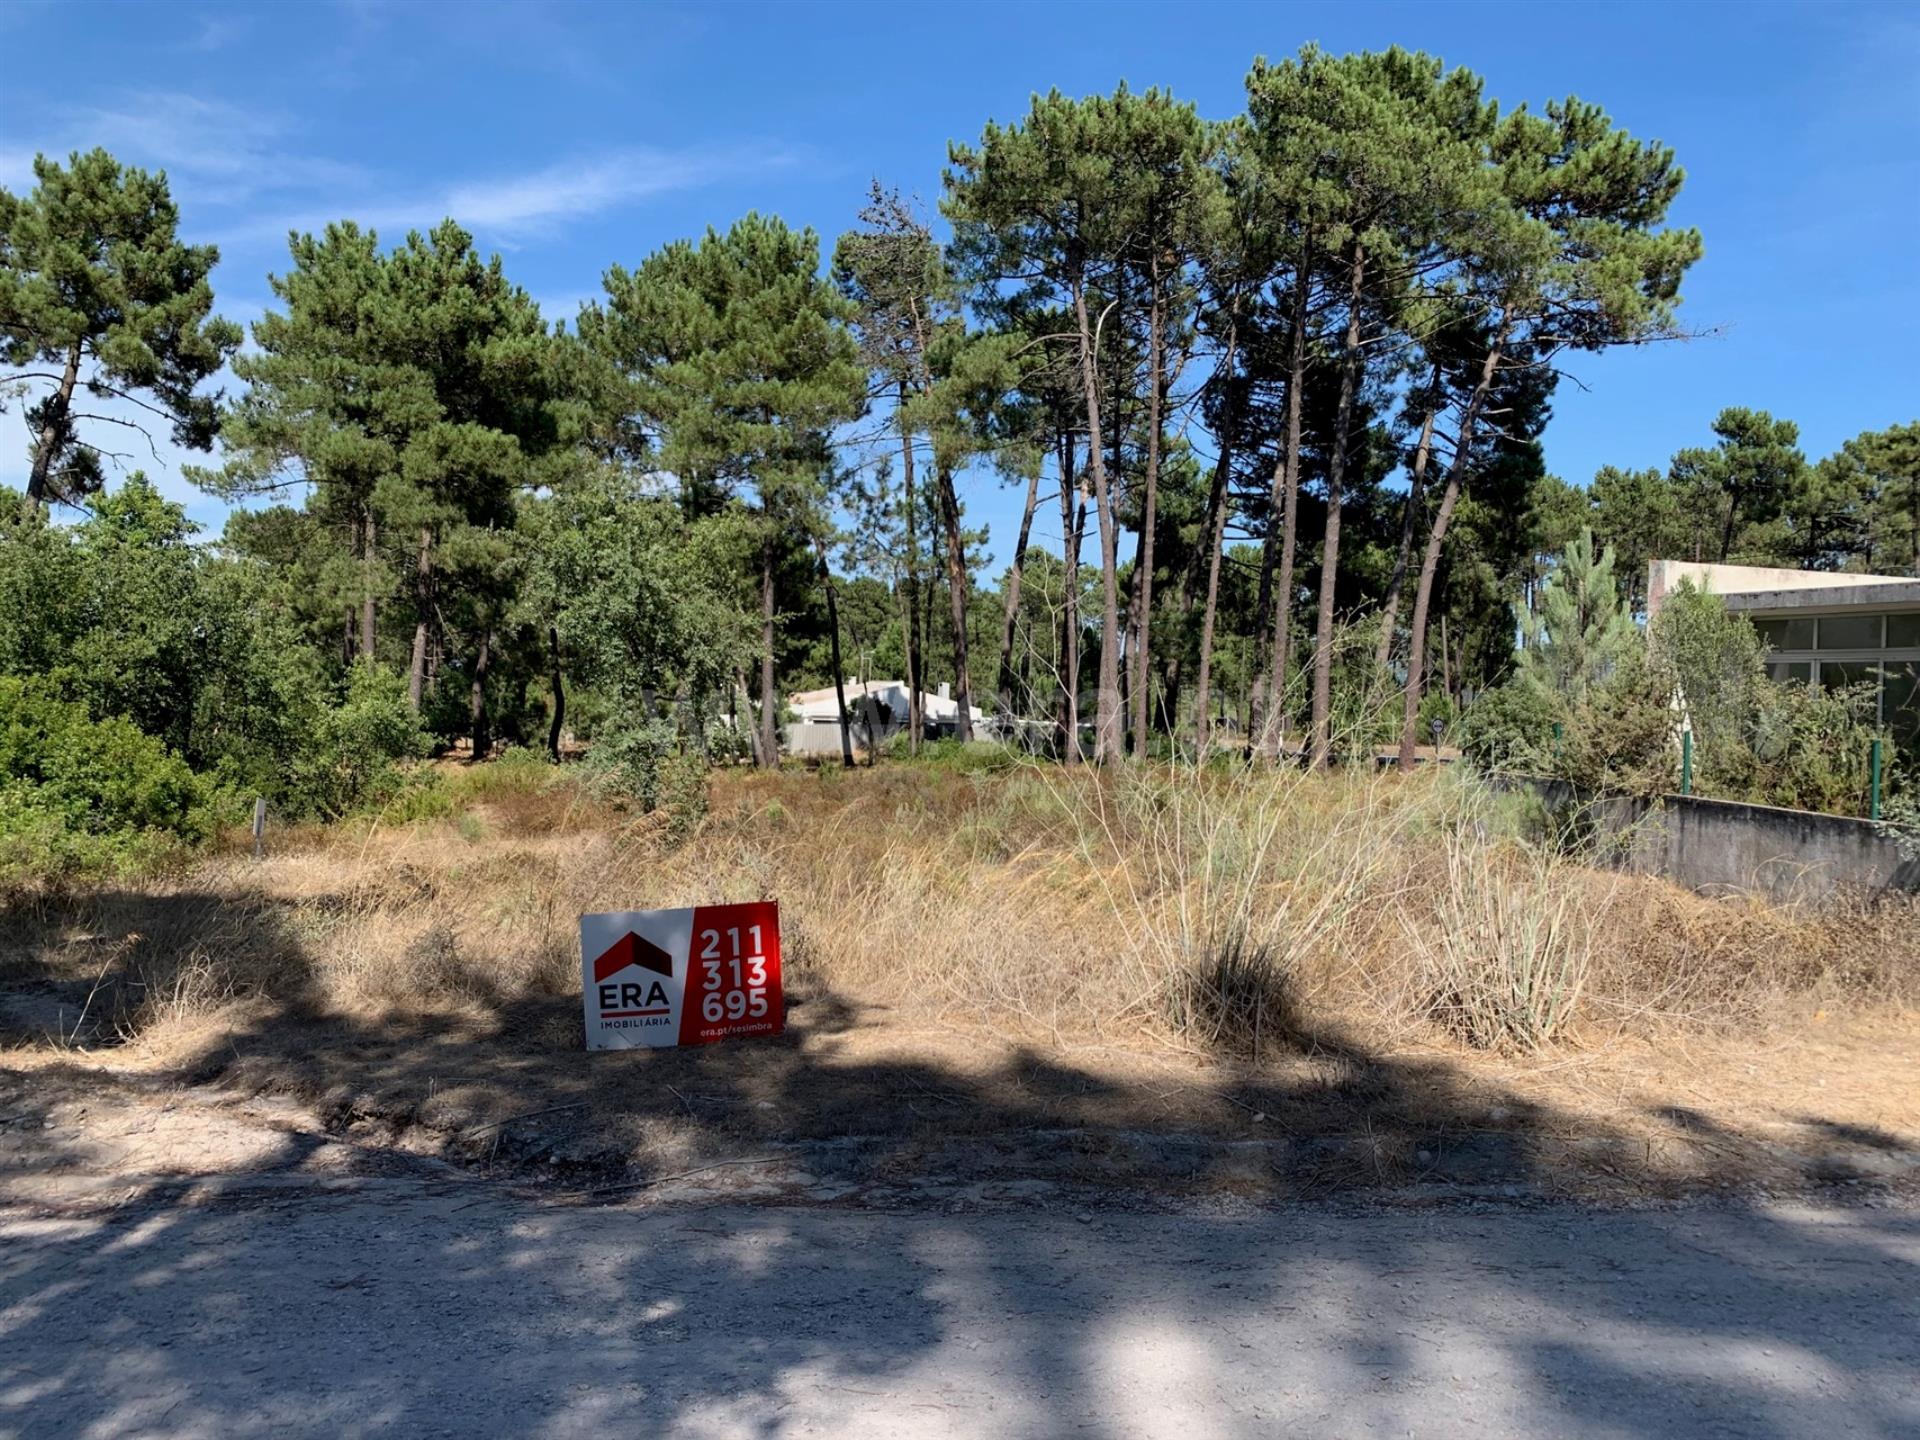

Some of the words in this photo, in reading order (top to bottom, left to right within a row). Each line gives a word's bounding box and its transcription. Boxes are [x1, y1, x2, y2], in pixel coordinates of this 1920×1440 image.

[701, 925, 762, 959] 211
[702, 955, 767, 990] 313
[599, 981, 669, 1010] ERA
[702, 987, 768, 1022] 695
[600, 1016, 671, 1030] IMOBILIÁRIA
